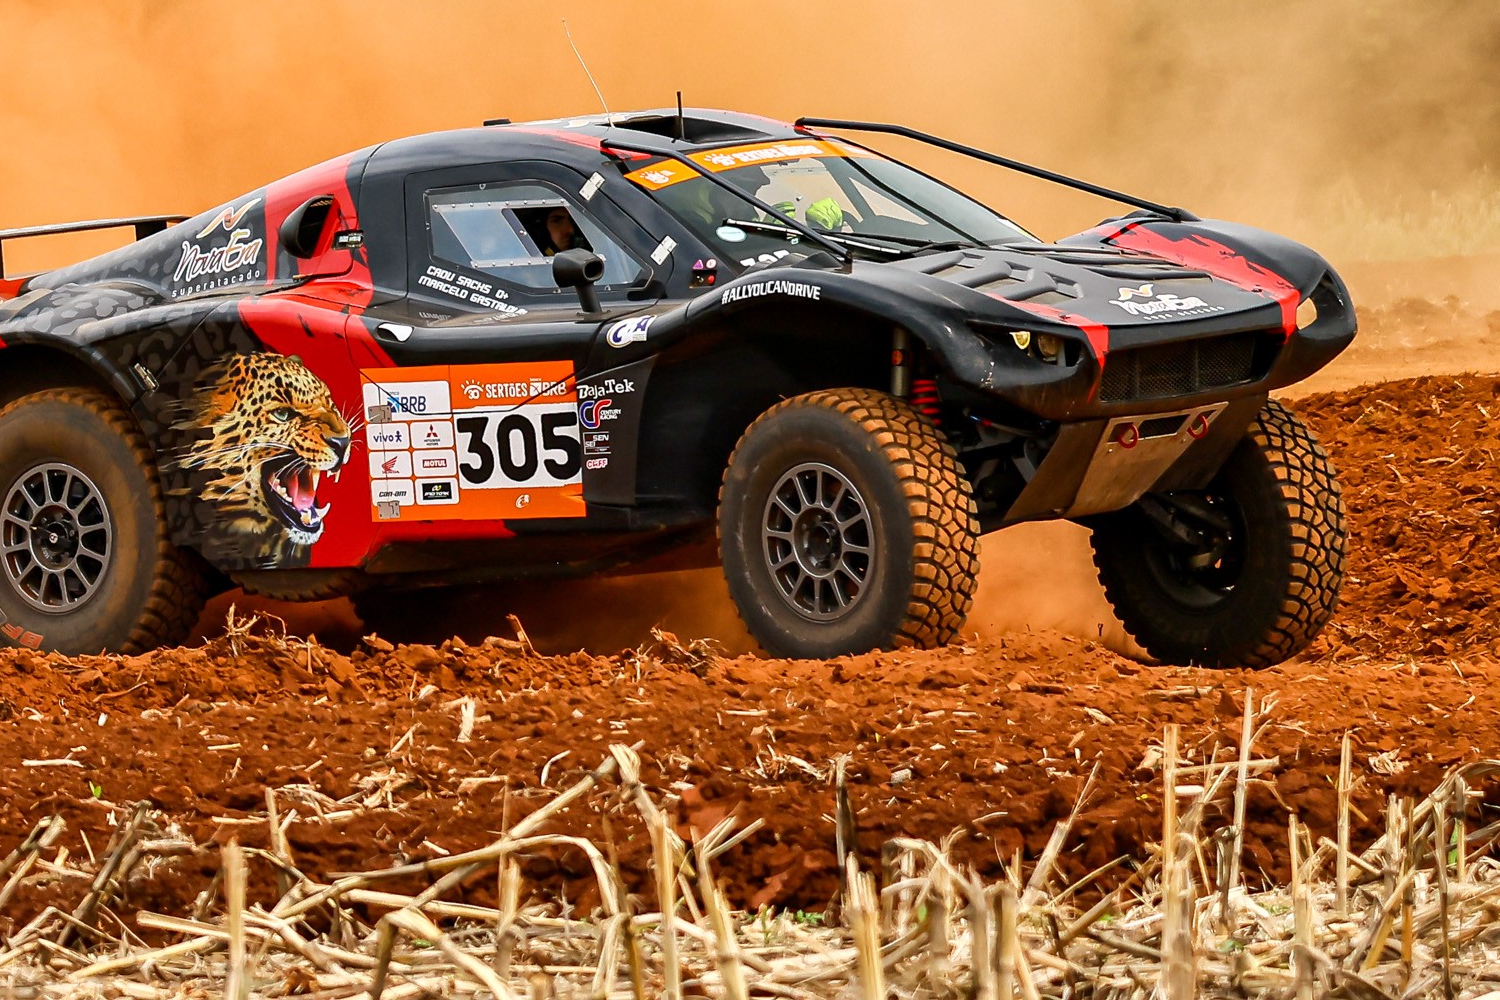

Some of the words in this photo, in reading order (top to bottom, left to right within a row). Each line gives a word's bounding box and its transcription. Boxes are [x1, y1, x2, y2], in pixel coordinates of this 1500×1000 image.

[172, 270, 260, 297] superatacado
[418, 275, 468, 299] MARCELO
[426, 265, 456, 281] CADU
[456, 275, 492, 294] SACHS
[722, 280, 821, 304] #ALLYOUCANDRIVE
[542, 381, 567, 396] BRB
[401, 396, 426, 412] BRB
[373, 432, 394, 442] vivo
[456, 411, 581, 484] 305
[423, 460, 447, 468] MOTUL
